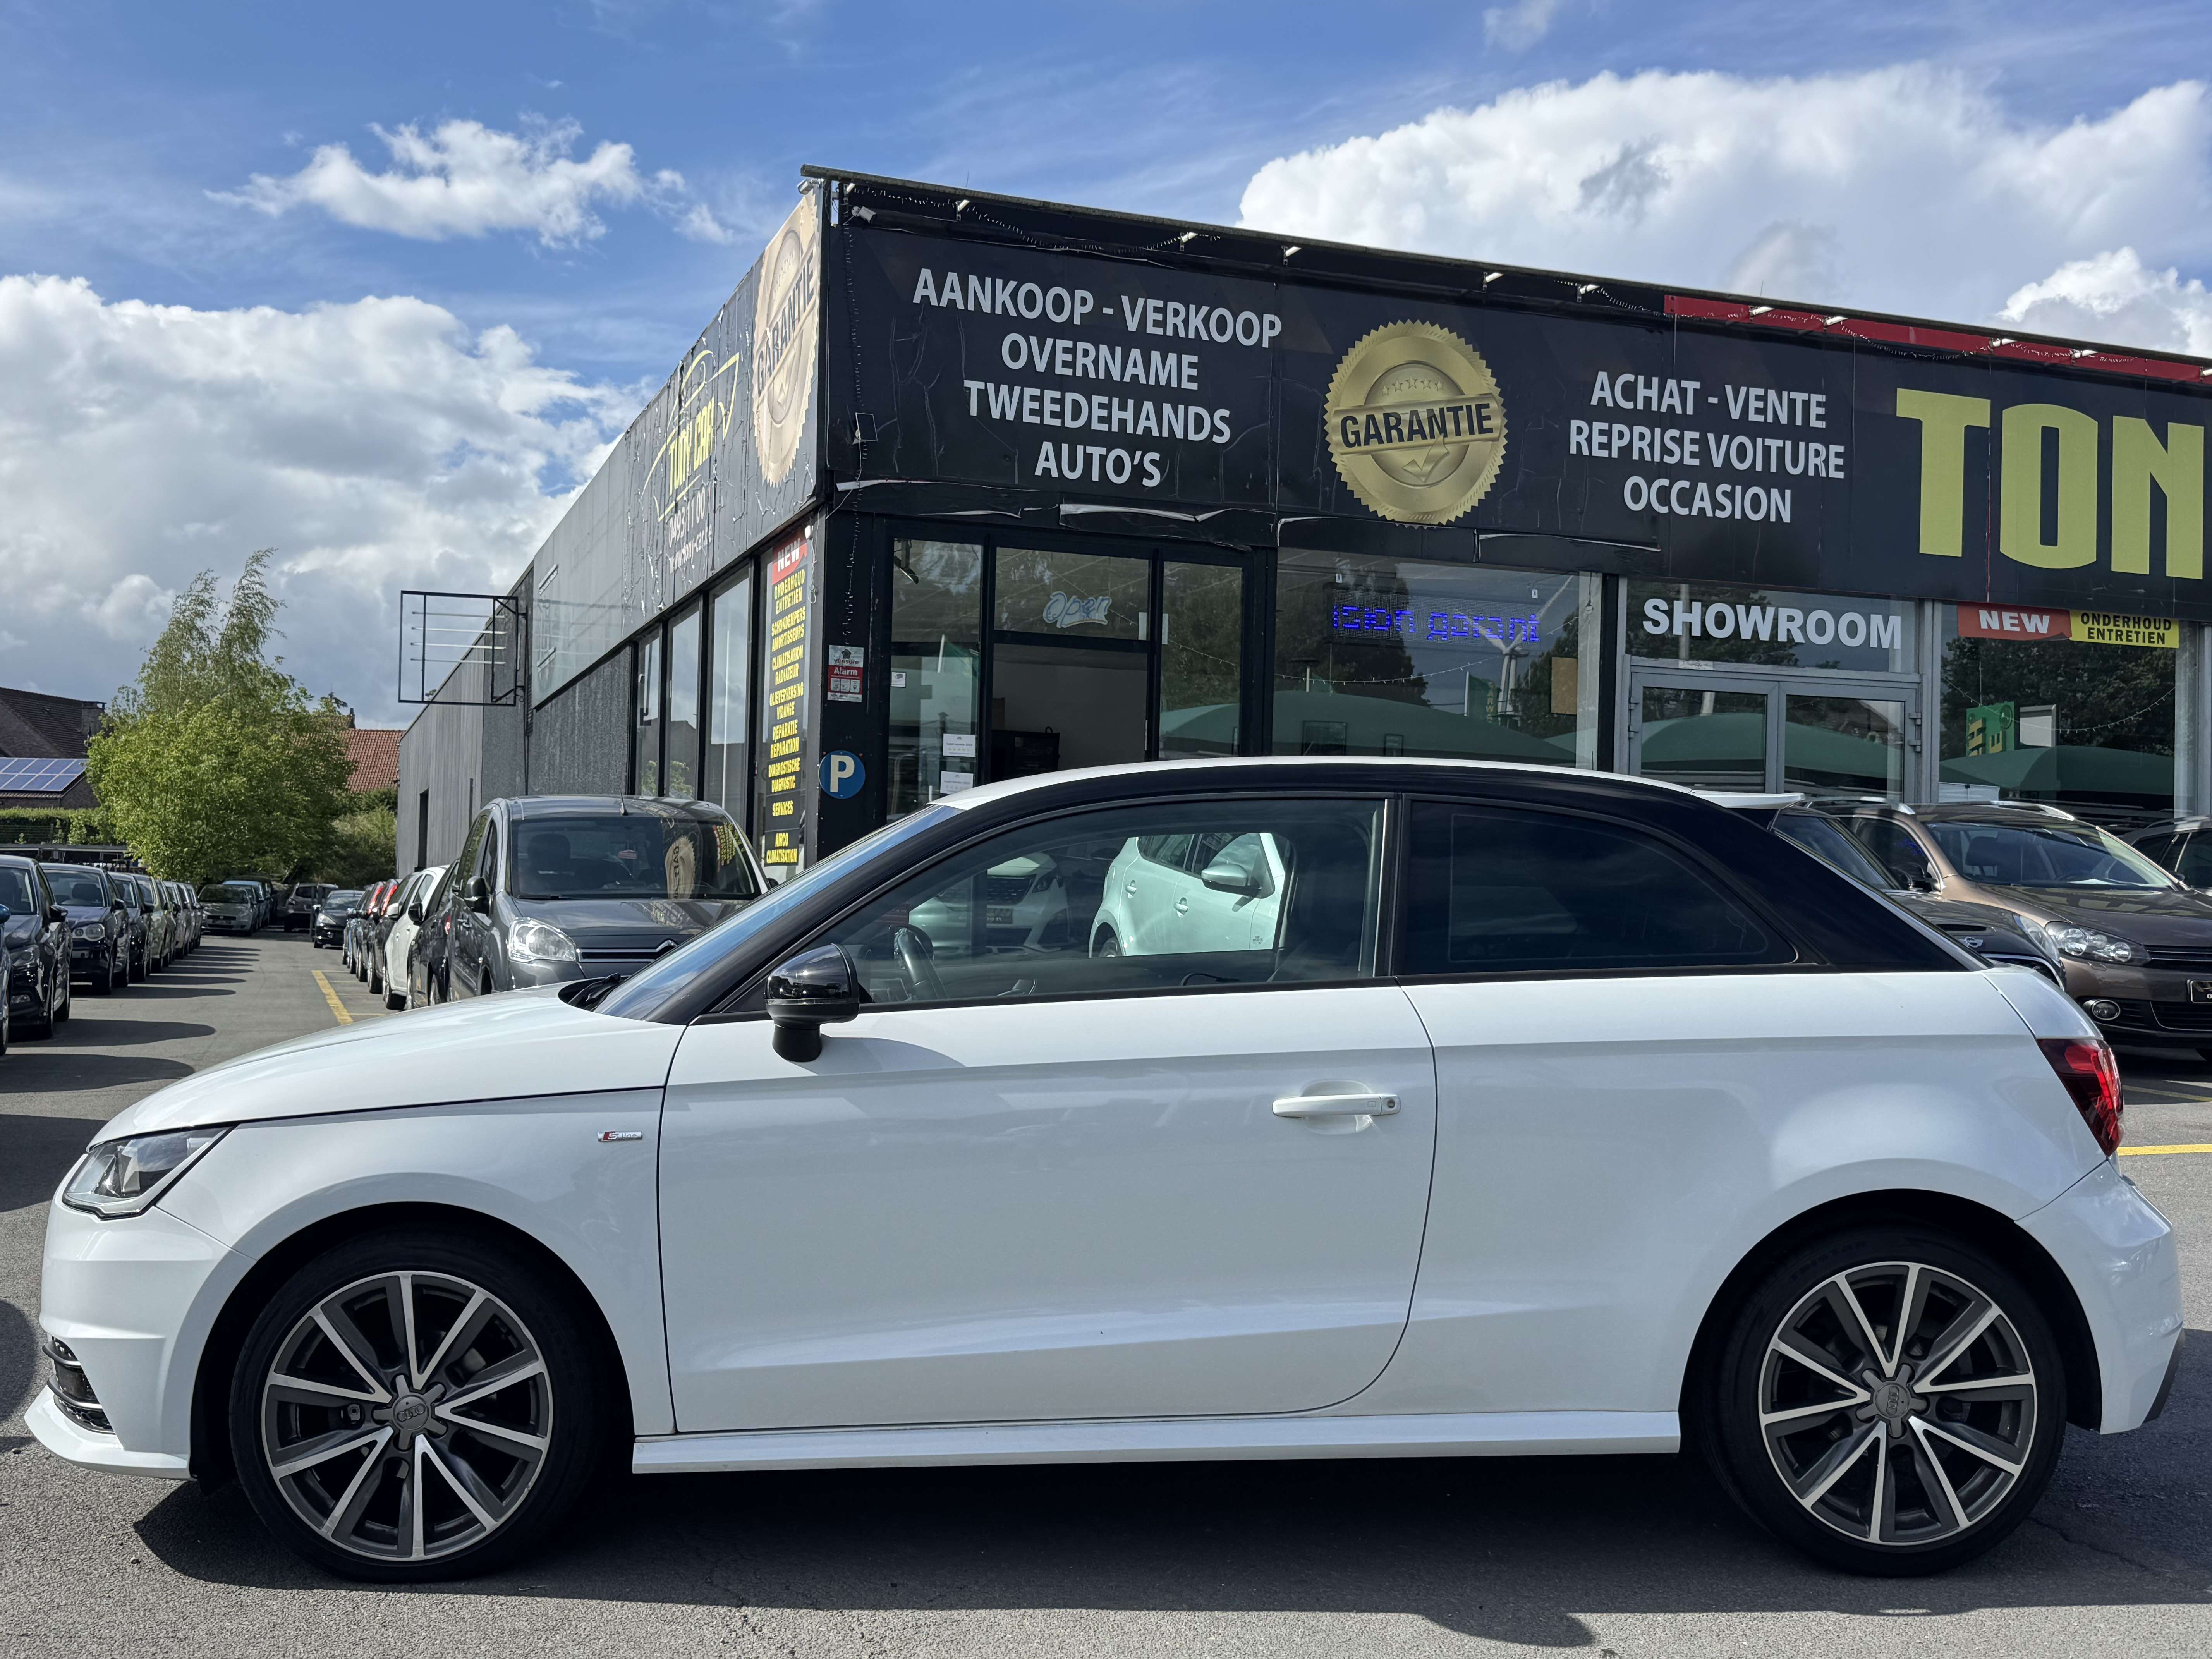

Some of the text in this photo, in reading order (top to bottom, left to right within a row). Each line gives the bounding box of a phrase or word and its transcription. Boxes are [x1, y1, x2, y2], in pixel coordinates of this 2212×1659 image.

[913, 268, 1094, 325] AANKOOP
[1121, 295, 1282, 349] VERKOOP
[757, 252, 814, 397] GARANTIE
[1001, 333, 1199, 390] OVERNAME
[964, 380, 1230, 444] TWEEDEHANDS
[1590, 371, 1700, 415] ACHAT
[1725, 385, 1827, 428] VENTE
[1341, 404, 1494, 447] GARANTIE
[1034, 441, 1161, 487] AUTO'S
[1570, 419, 1844, 479] REPRISE VOITURE
[1623, 475, 1791, 523] OCCASION
[1896, 388, 2203, 579] TON
[778, 538, 800, 572] NEW
[775, 569, 805, 600] ONDERHOUD
[776, 587, 802, 615] ENTRETIEN
[1044, 591, 1112, 628] Open
[771, 606, 805, 637] SCHOKDEMPERS
[1642, 598, 1901, 650] SHOWROOM
[1979, 610, 2050, 634] NEW
[2080, 612, 2172, 632] ONDERHOUD
[2087, 627, 2166, 645] ENTRETIEN
[772, 623, 804, 652] AMORTISSEURS
[772, 644, 803, 671] CLIMATISATION
[834, 667, 858, 676] Alarm
[775, 663, 799, 685] RADIATEUR
[777, 701, 795, 720] VIDANGE
[768, 757, 800, 778] DIAGNOSTISCHE
[830, 754, 855, 793] P
[772, 775, 796, 793] DIAGNOSTIC
[773, 800, 793, 816] SERVICES
[775, 833, 789, 847] AIRCO
[766, 848, 797, 864] CLIMATISATION
